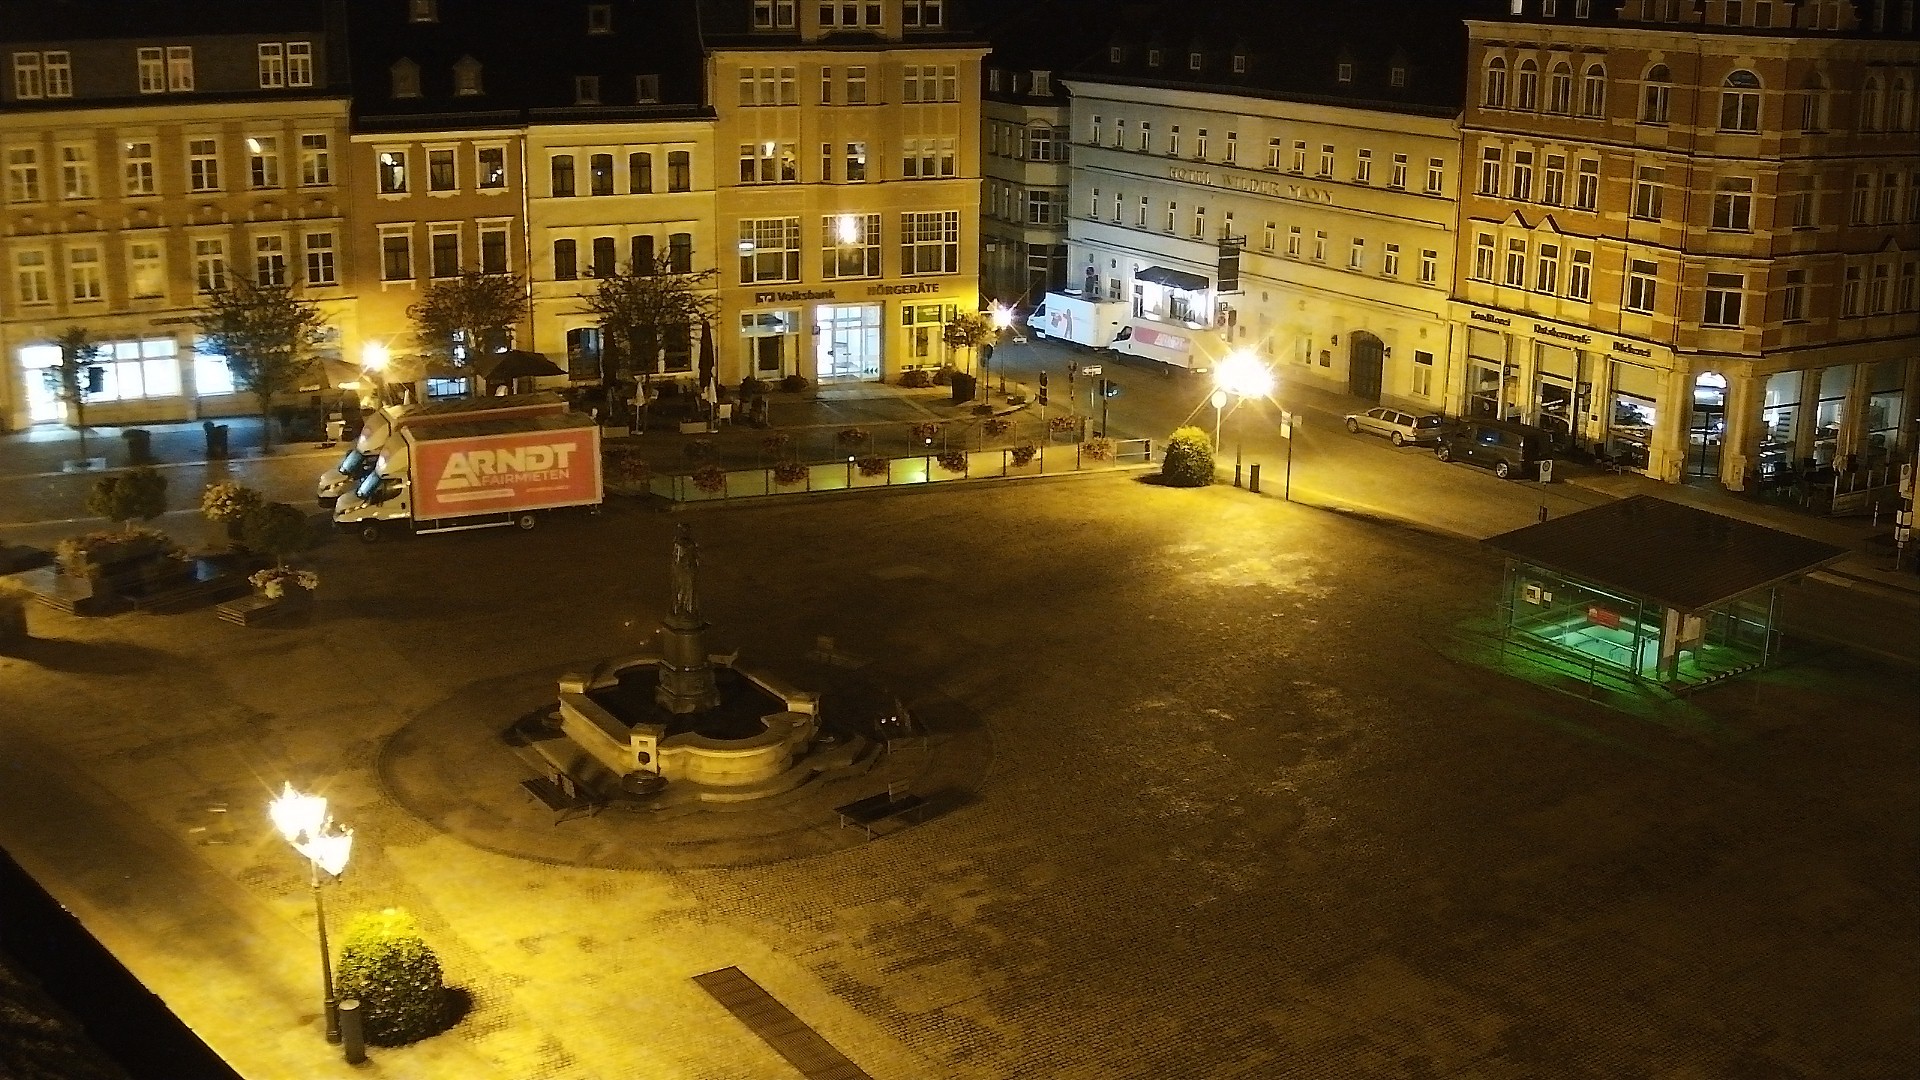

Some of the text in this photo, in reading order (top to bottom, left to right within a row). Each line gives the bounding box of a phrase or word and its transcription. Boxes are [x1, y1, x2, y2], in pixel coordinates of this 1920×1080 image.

[1169, 166, 1213, 186] HOTEL
[1222, 174, 1280, 196] WILDER
[778, 289, 836, 302] Volksbank
[867, 282, 940, 296] HÖRGERÄTE
[436, 443, 577, 490] ARNDT
[482, 468, 570, 486] FAIRMIETEN
